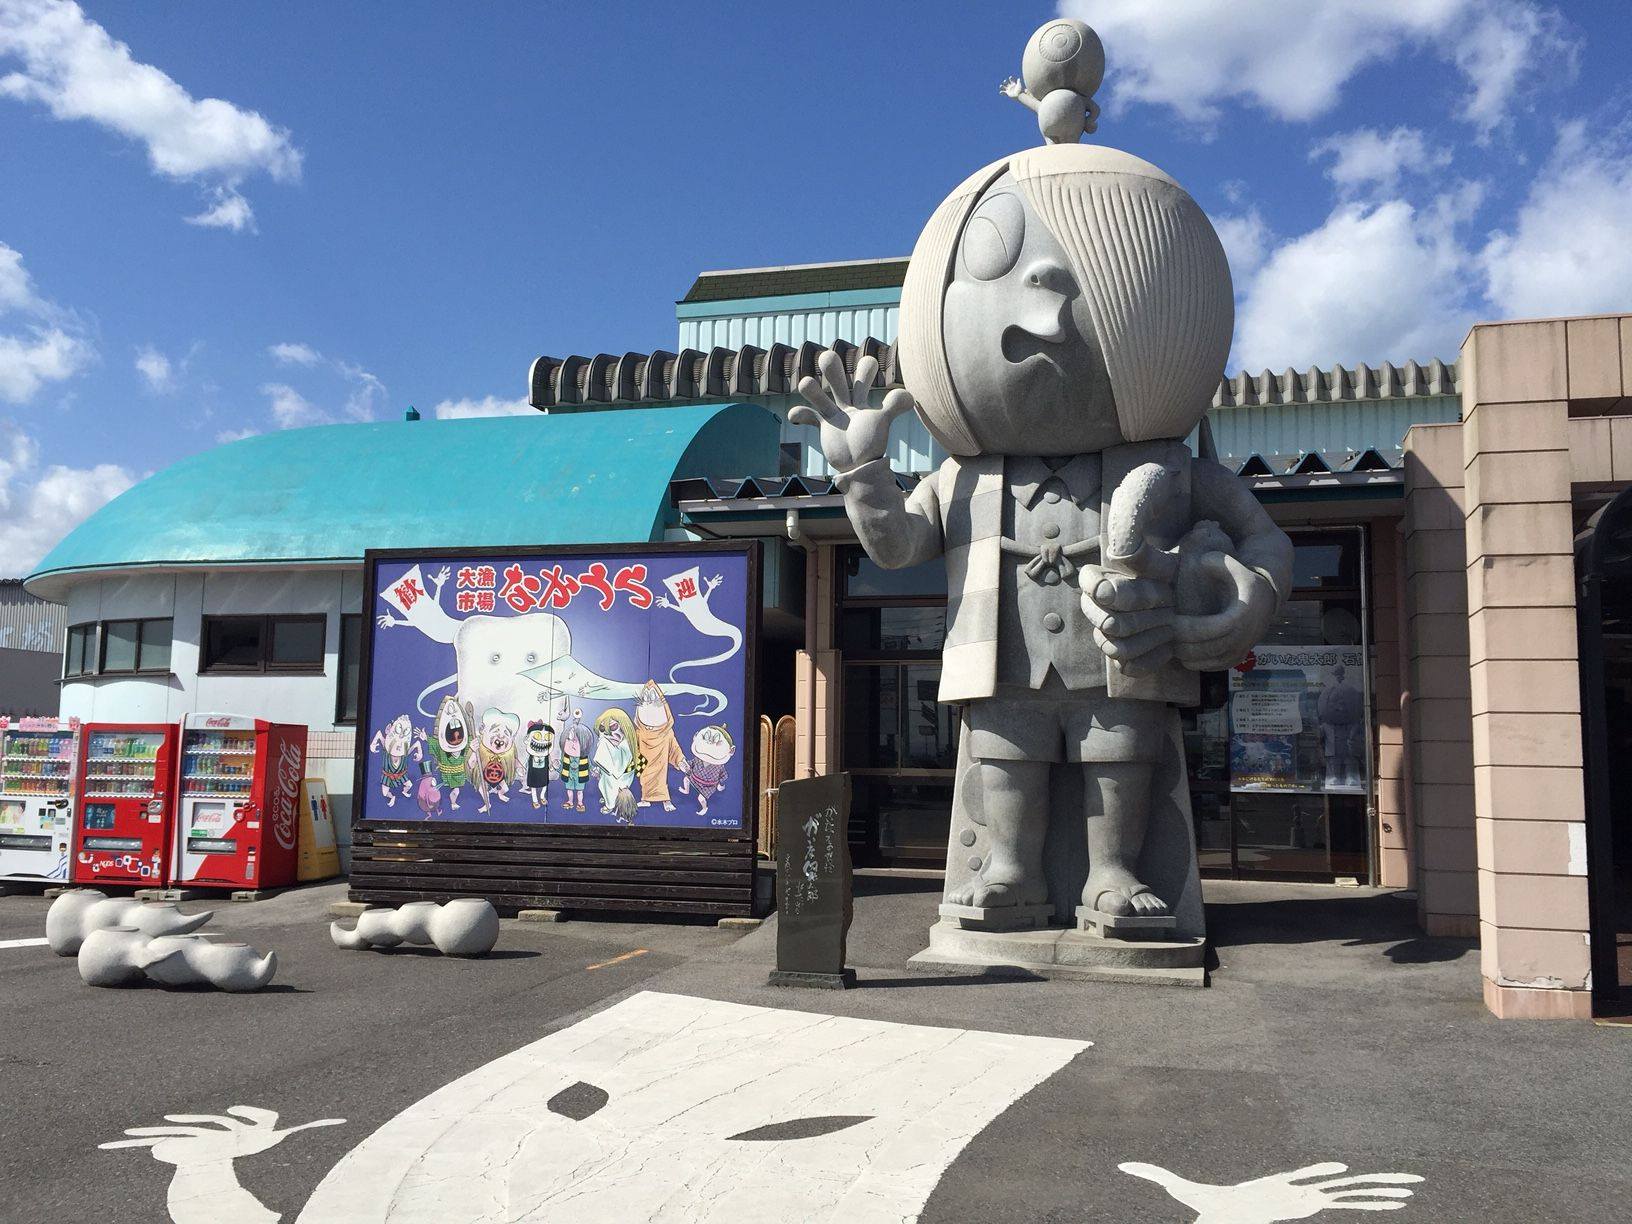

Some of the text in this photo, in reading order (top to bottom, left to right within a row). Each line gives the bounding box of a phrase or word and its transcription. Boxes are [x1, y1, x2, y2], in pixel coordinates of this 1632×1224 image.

[456, 566, 497, 588] 大漁
[497, 563, 653, 613] なかうら
[393, 578, 425, 611] 歓
[674, 577, 697, 601] 迎
[456, 590, 496, 612] 市場
[1257, 652, 1338, 667] がいな鬼太郎
